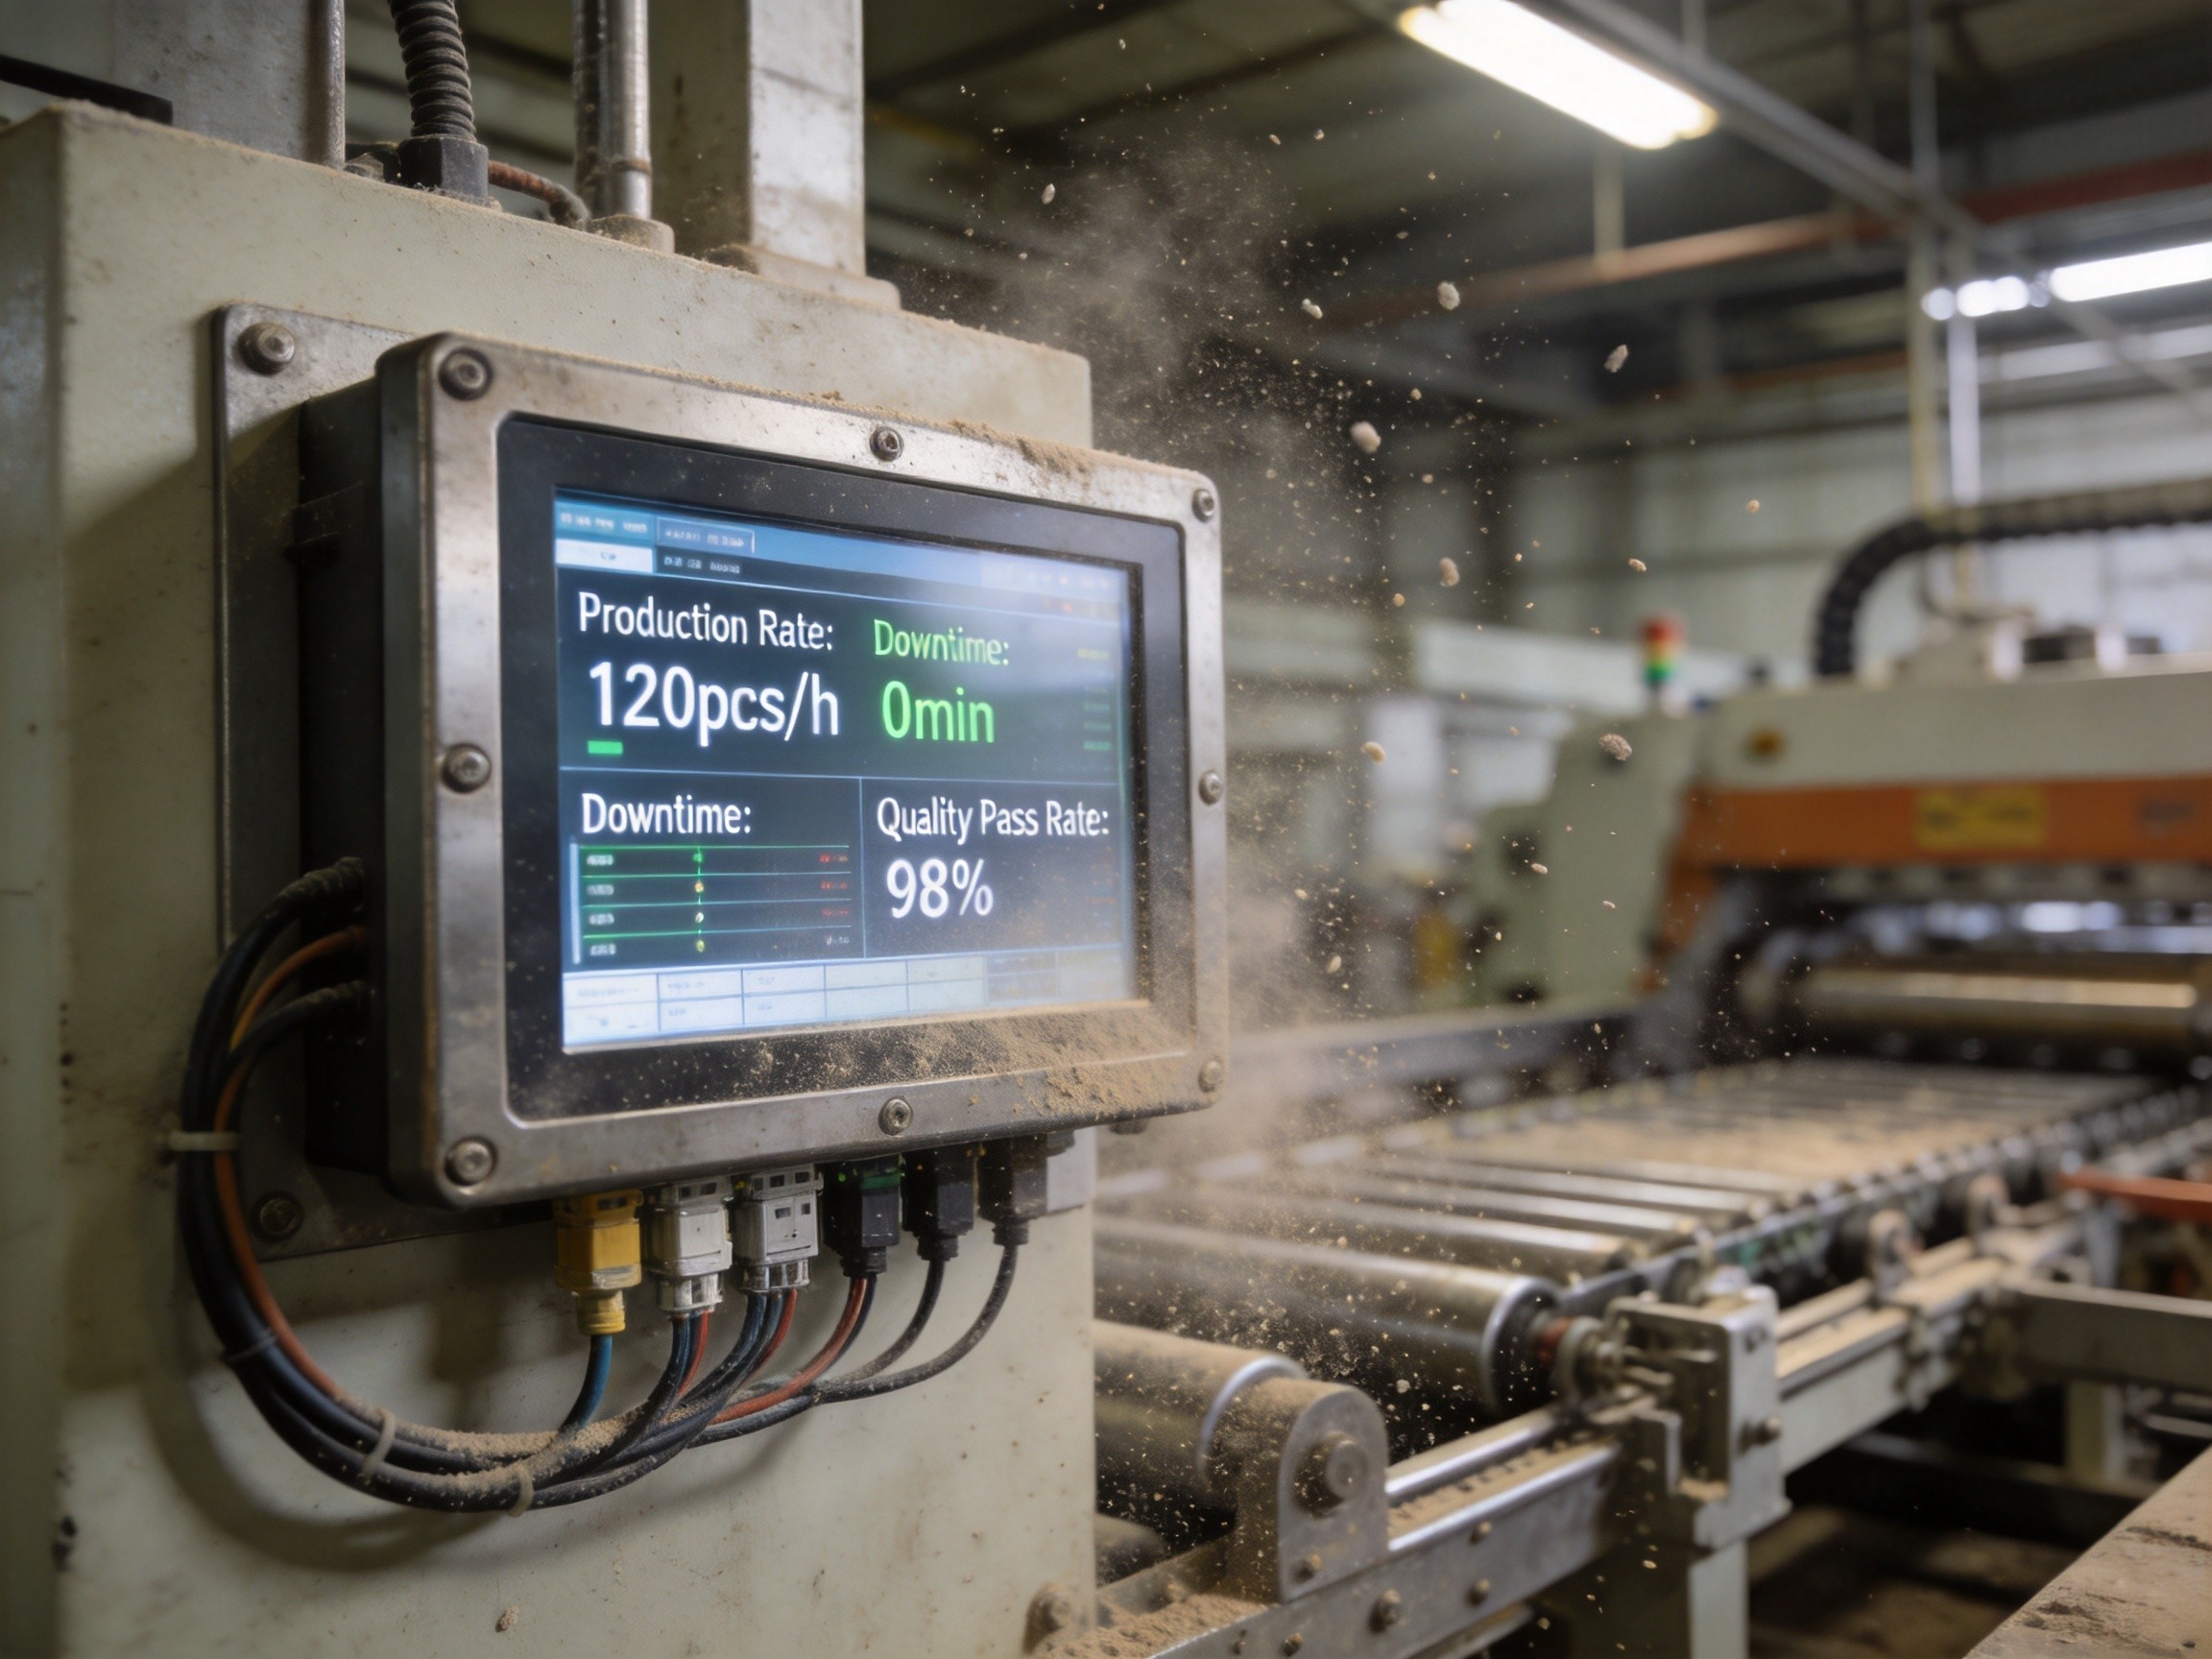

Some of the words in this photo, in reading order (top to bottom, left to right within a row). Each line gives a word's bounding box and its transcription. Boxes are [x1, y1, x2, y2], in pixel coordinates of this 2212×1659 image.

[578, 591, 748, 645] Production
[758, 609, 833, 651] Rate:
[874, 618, 1009, 665] Downtime:
[589, 661, 839, 747] 120pcs/h
[881, 680, 996, 744] 0min
[582, 792, 751, 834] Downtime:
[877, 796, 974, 845] Quality
[980, 799, 1039, 836] Pass
[1046, 800, 1110, 836] Rate:
[886, 858, 995, 919] 98%
